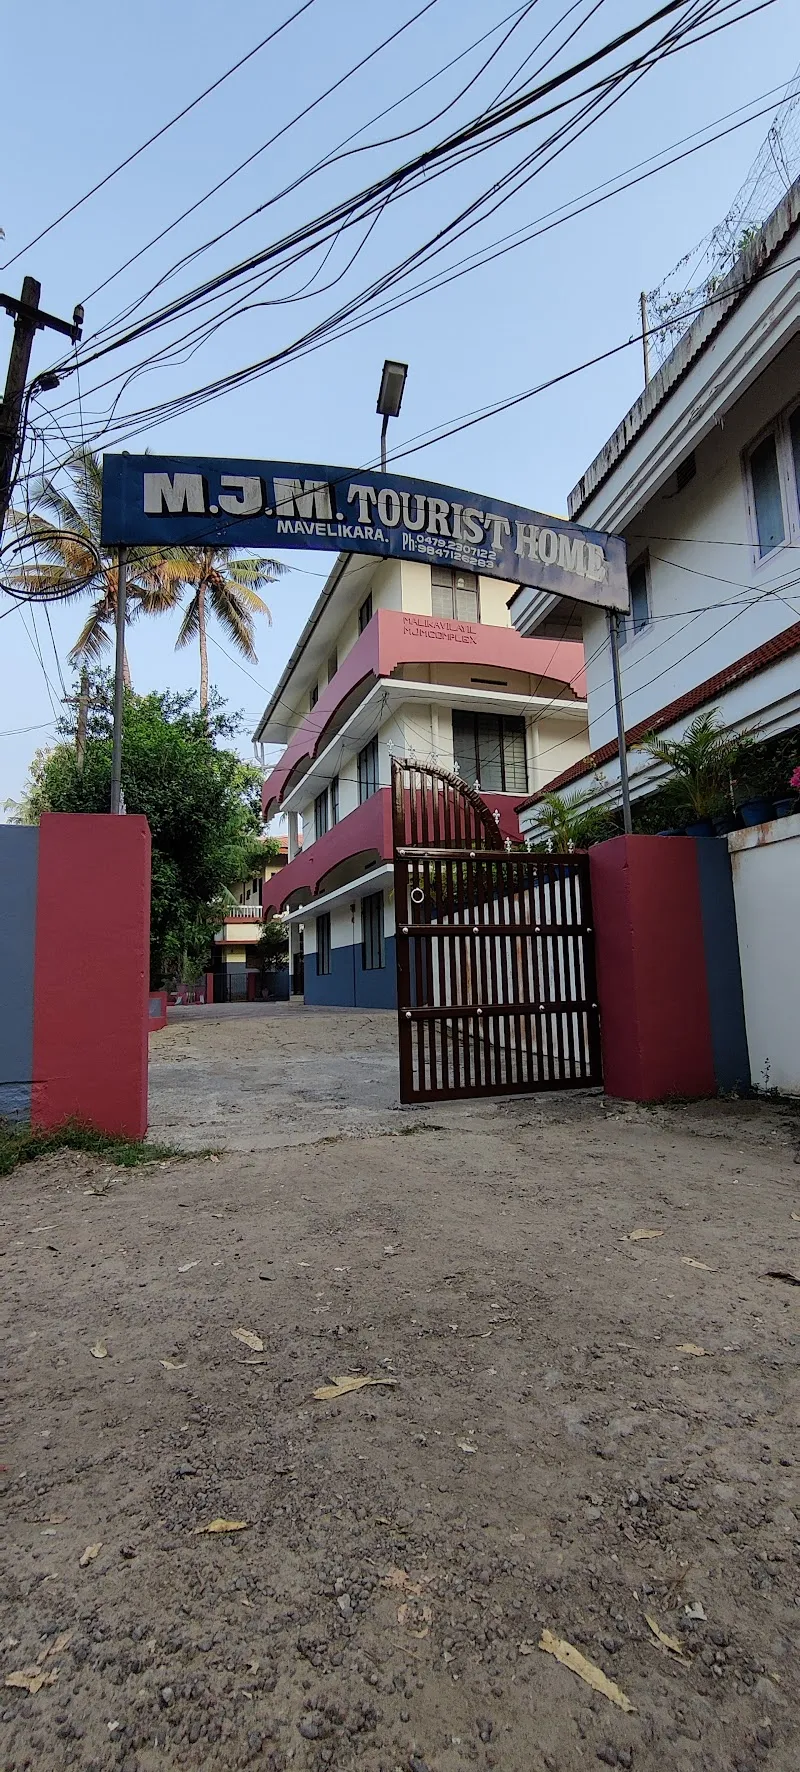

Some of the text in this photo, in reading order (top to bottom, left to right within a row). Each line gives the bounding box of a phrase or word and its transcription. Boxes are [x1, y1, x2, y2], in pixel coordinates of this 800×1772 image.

[143, 472, 609, 583] M.J.M. TOURIST HOME
[277, 520, 389, 543] MAVELIKARA.
[416, 534, 497, 560] 0479.2307122
[418, 544, 494, 568] 9847126283
